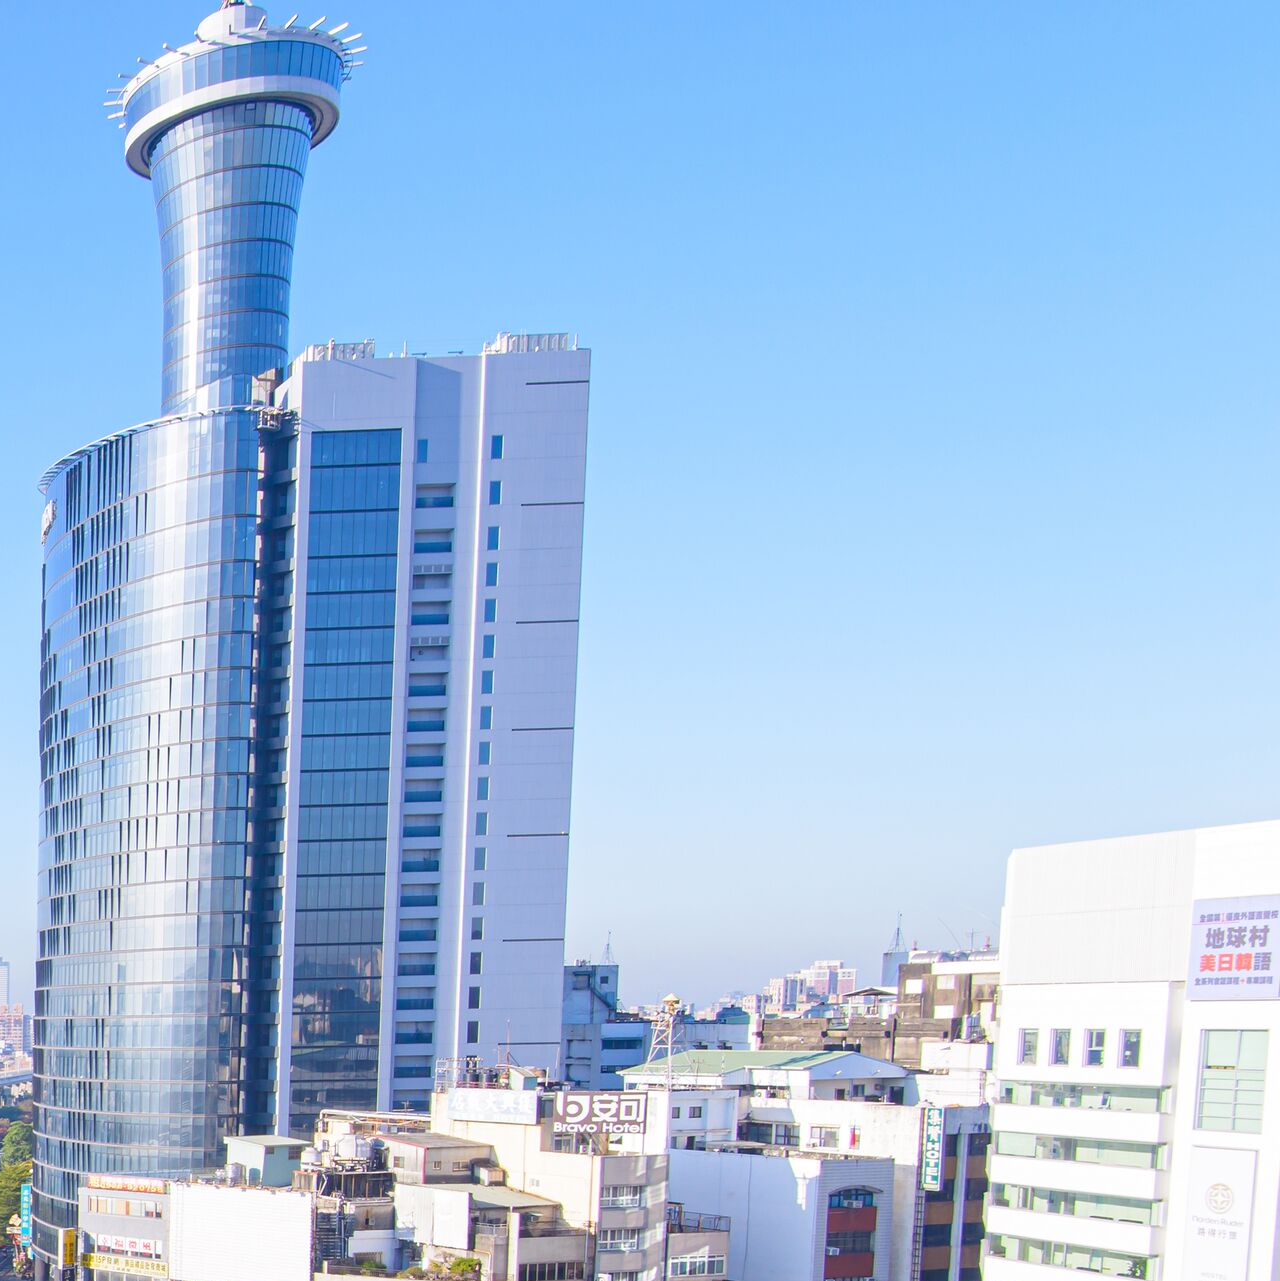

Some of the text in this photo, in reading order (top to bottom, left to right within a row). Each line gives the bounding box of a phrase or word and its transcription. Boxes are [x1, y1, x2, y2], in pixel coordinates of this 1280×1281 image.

[1205, 925, 1270, 949] 地球村
[1199, 952, 1272, 972] 美日韓語
[591, 1094, 646, 1122] 安可
[553, 1121, 644, 1133] Bravo Hotel
[925, 1141, 940, 1184] HOTEL
